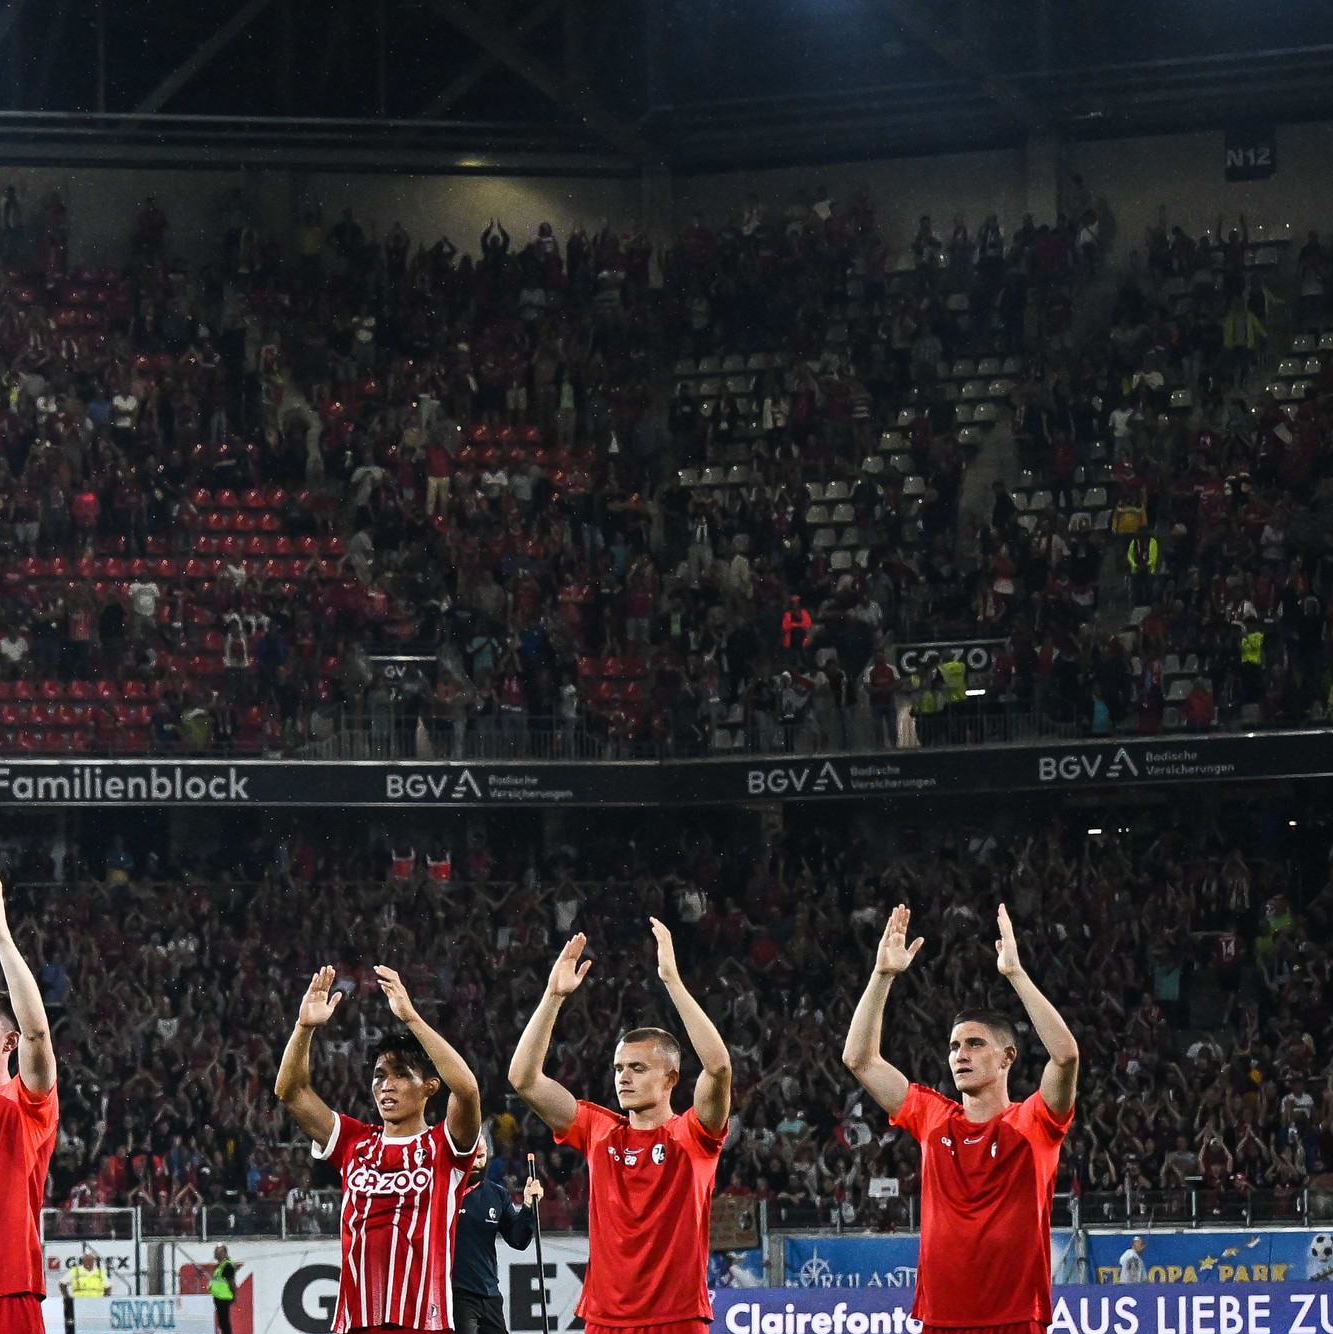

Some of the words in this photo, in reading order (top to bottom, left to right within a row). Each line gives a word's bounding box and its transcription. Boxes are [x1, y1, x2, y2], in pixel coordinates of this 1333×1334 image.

[1227, 147, 1271, 167] N12
[348, 1167, 430, 1193] CAZOO
[1219, 1264, 1288, 1283] PARK
